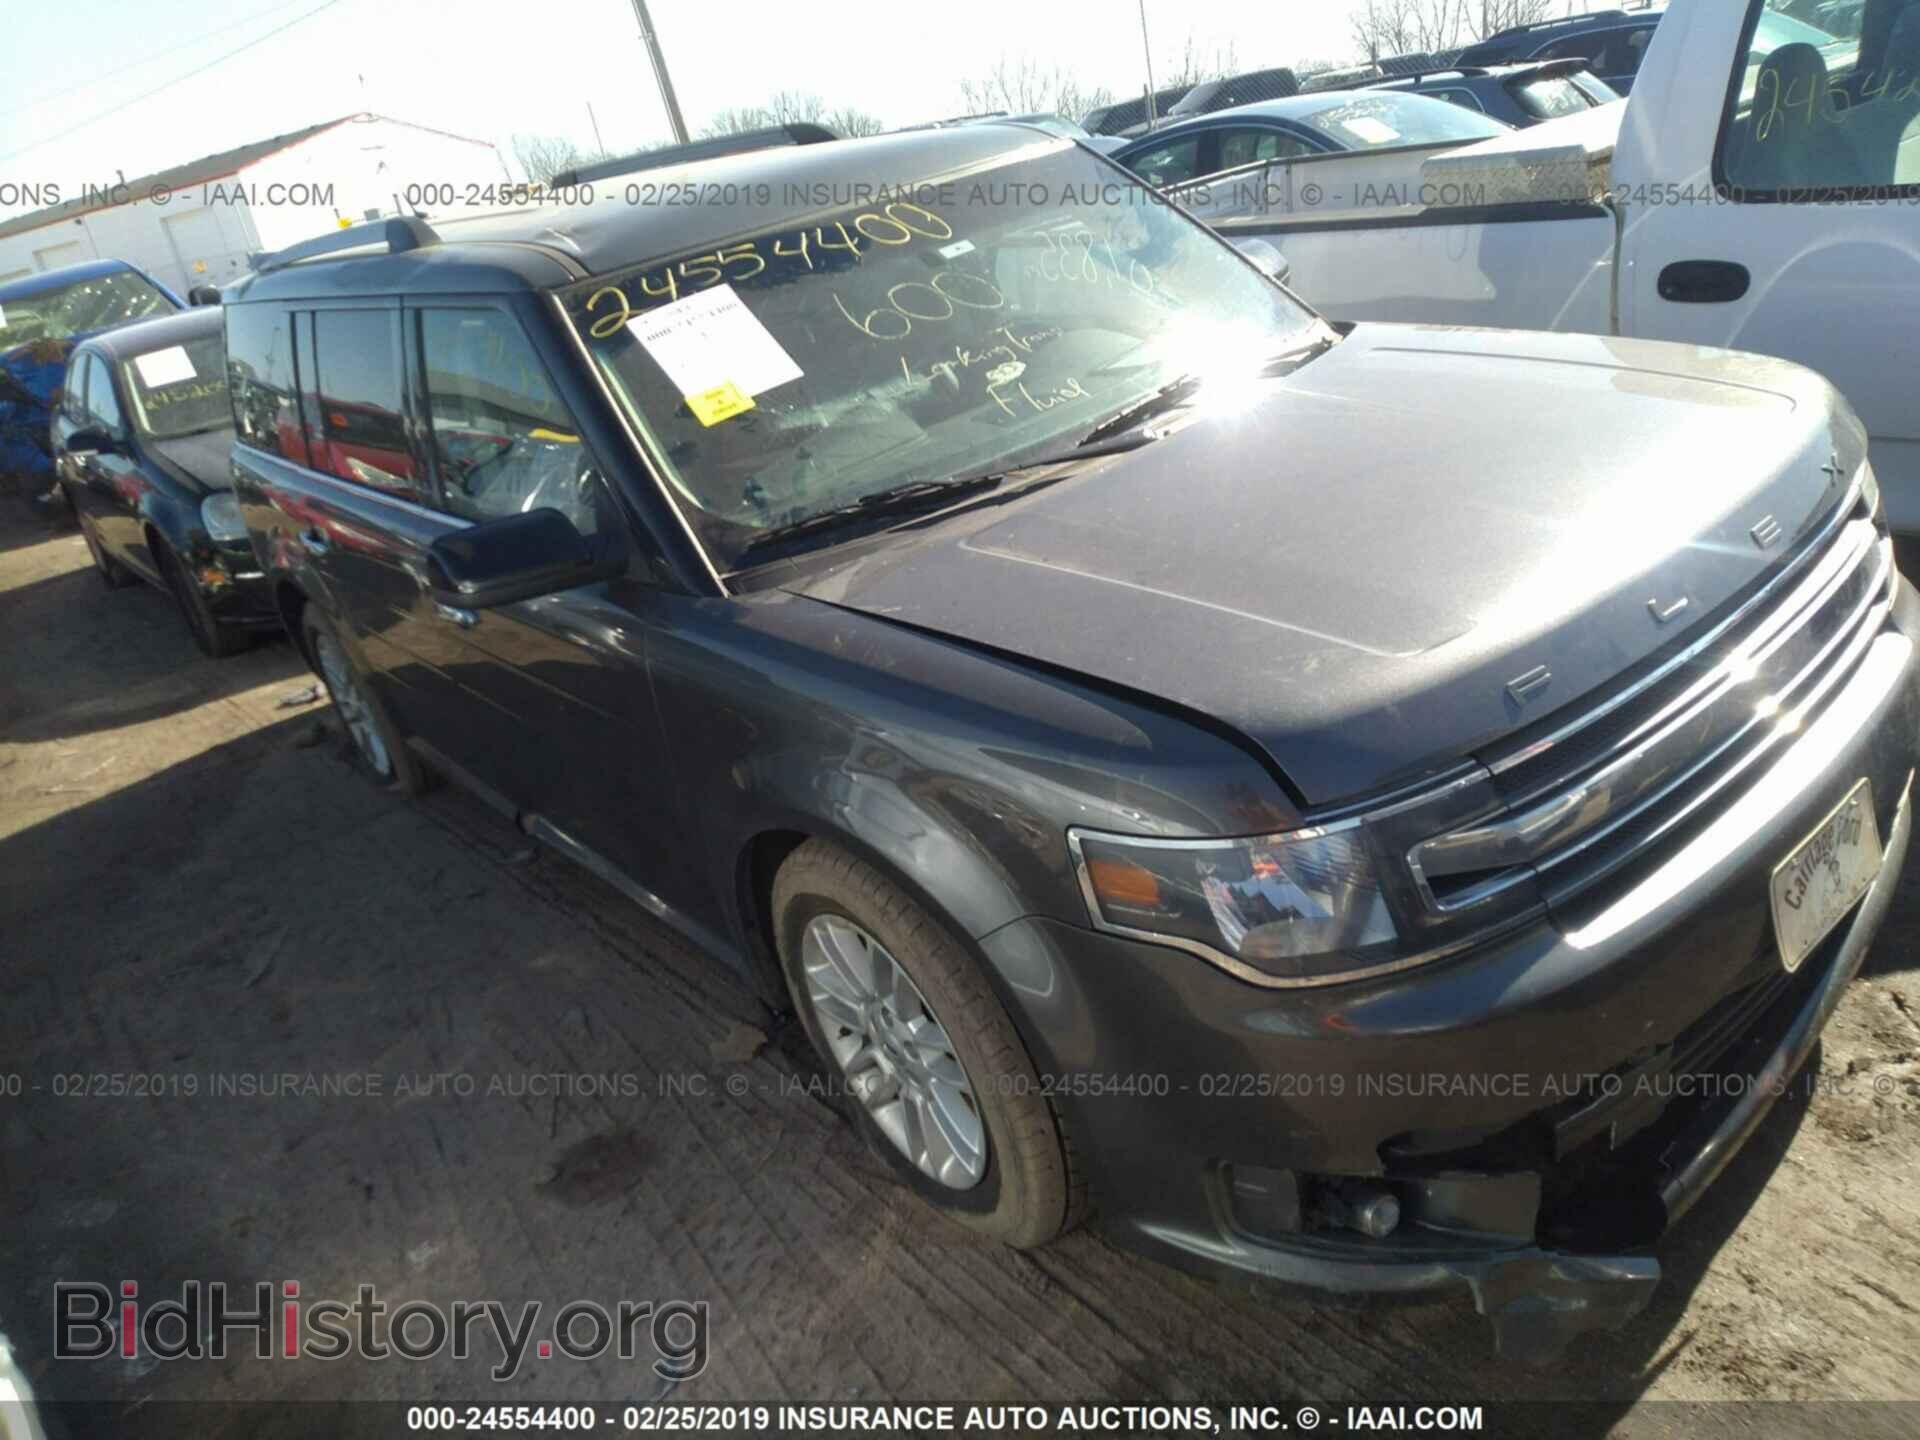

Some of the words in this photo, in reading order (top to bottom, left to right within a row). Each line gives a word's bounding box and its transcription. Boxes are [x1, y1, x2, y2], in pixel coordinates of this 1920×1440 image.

[587, 203, 952, 338] 24554400
[832, 272, 1003, 340] 600
[1505, 453, 1844, 706] FLEX
